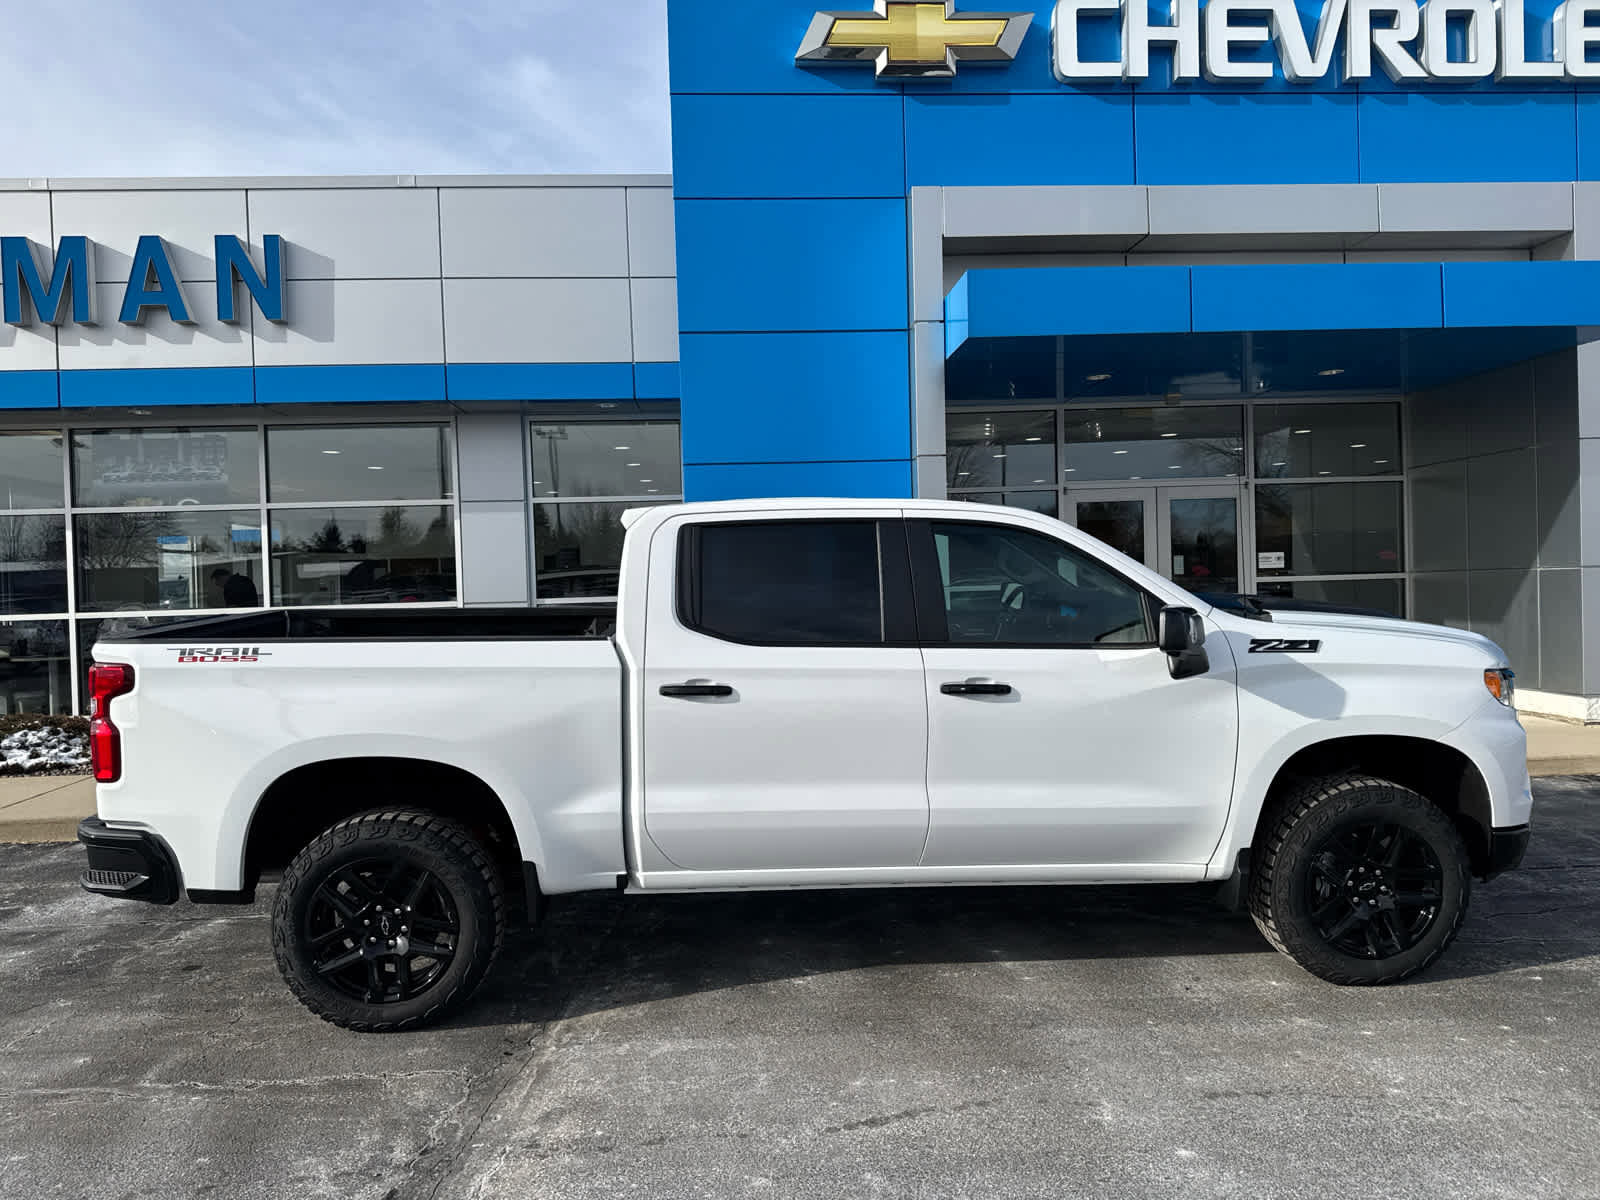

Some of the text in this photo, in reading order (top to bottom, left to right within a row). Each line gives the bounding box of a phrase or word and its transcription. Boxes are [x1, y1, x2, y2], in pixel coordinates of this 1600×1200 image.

[0, 235, 288, 326] MAN
[167, 647, 273, 656] TRAIL
[1248, 638, 1321, 654] Z71
[178, 655, 259, 663] BOSS
